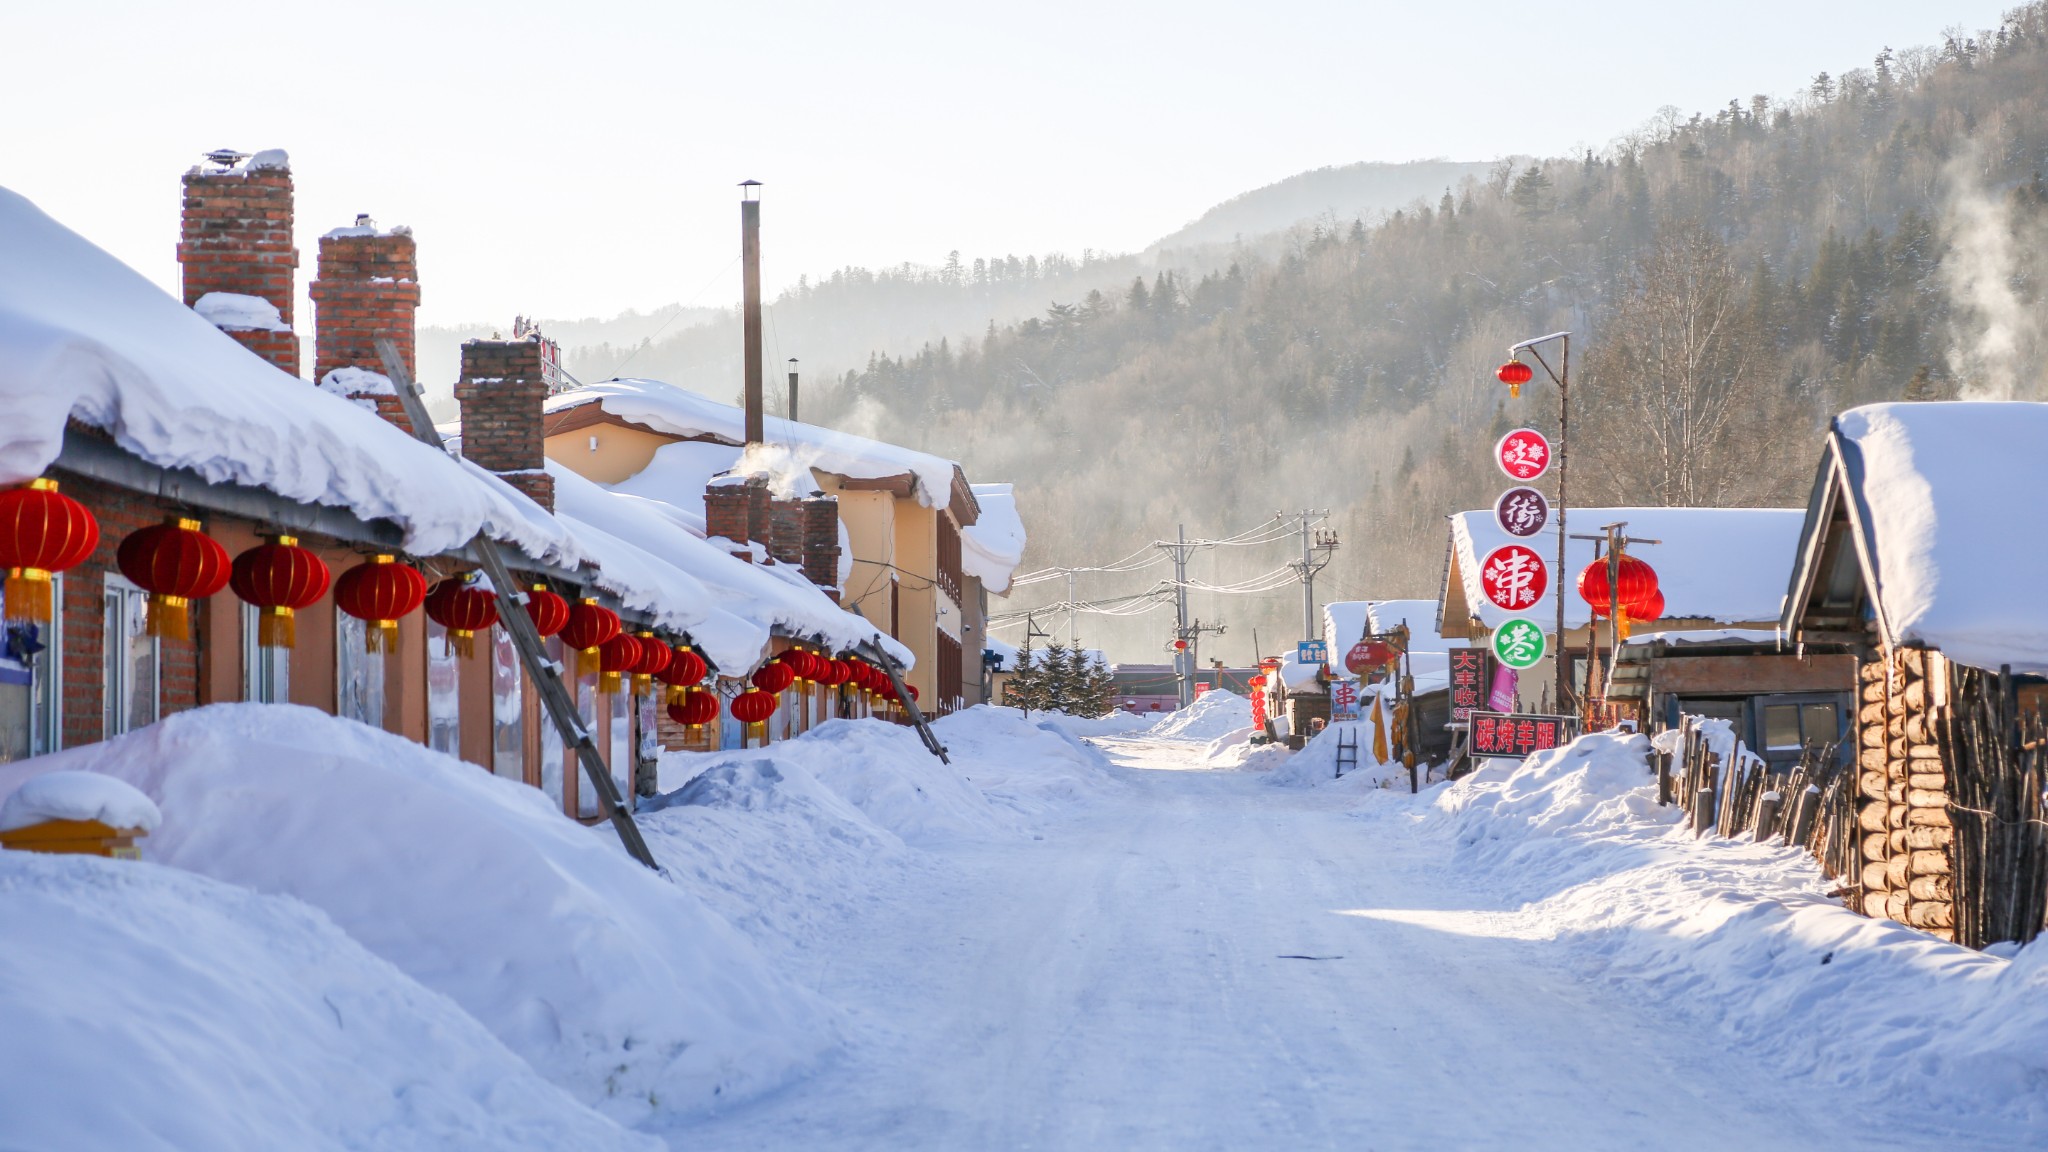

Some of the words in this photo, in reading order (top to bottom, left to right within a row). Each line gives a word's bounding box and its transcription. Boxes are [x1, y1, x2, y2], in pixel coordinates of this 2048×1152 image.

[1454, 651, 1477, 706] 大丰收
[1335, 683, 1357, 713] 串
[1476, 718, 1556, 755] 碳烤羊腿
